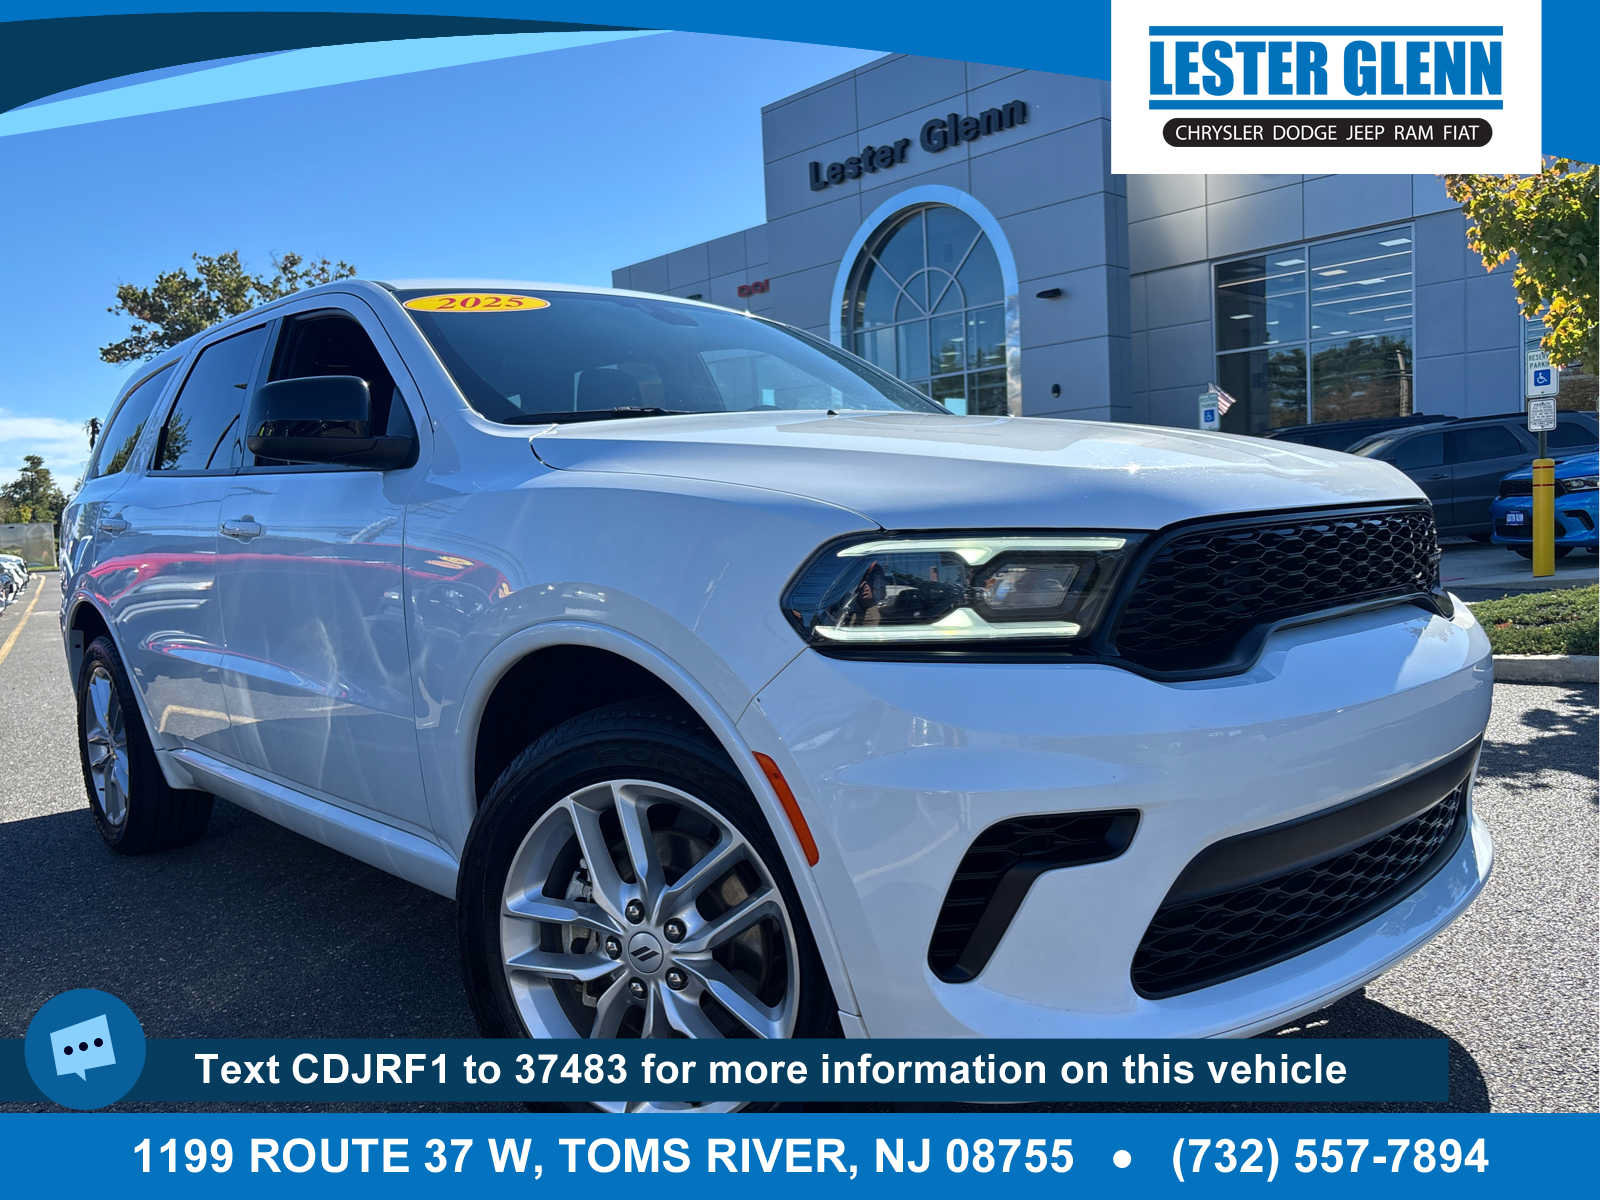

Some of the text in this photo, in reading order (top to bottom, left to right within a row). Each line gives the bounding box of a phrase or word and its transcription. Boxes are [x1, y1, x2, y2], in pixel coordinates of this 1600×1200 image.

[808, 99, 1029, 192] Lester Glenn
[436, 296, 524, 310] 2025
